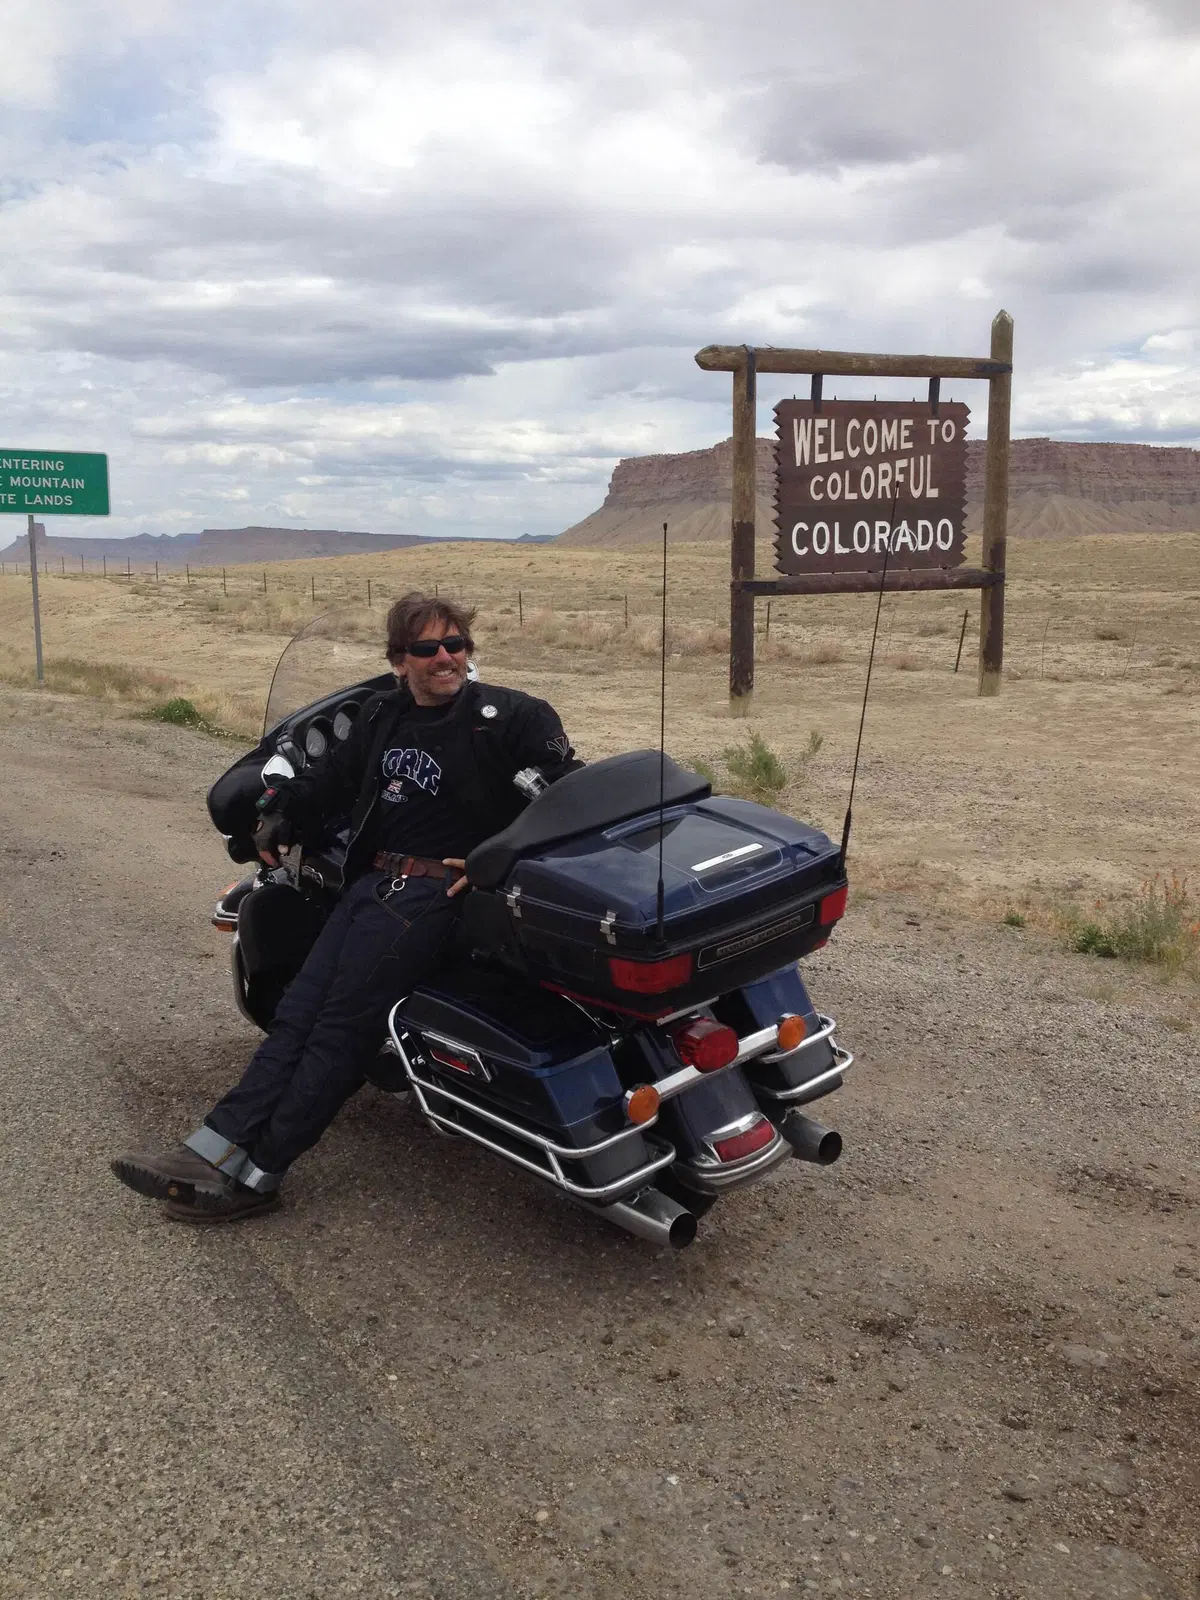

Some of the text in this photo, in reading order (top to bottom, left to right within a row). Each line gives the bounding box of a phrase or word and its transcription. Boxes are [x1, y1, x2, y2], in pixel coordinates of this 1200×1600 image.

[793, 418, 956, 467] WELCOME TO
[9, 476, 85, 489] MOUNTAIN
[810, 454, 939, 501] COLORFUL
[24, 494, 74, 506] LANDS
[791, 518, 954, 556] COLORADO
[381, 748, 442, 796] ORK
